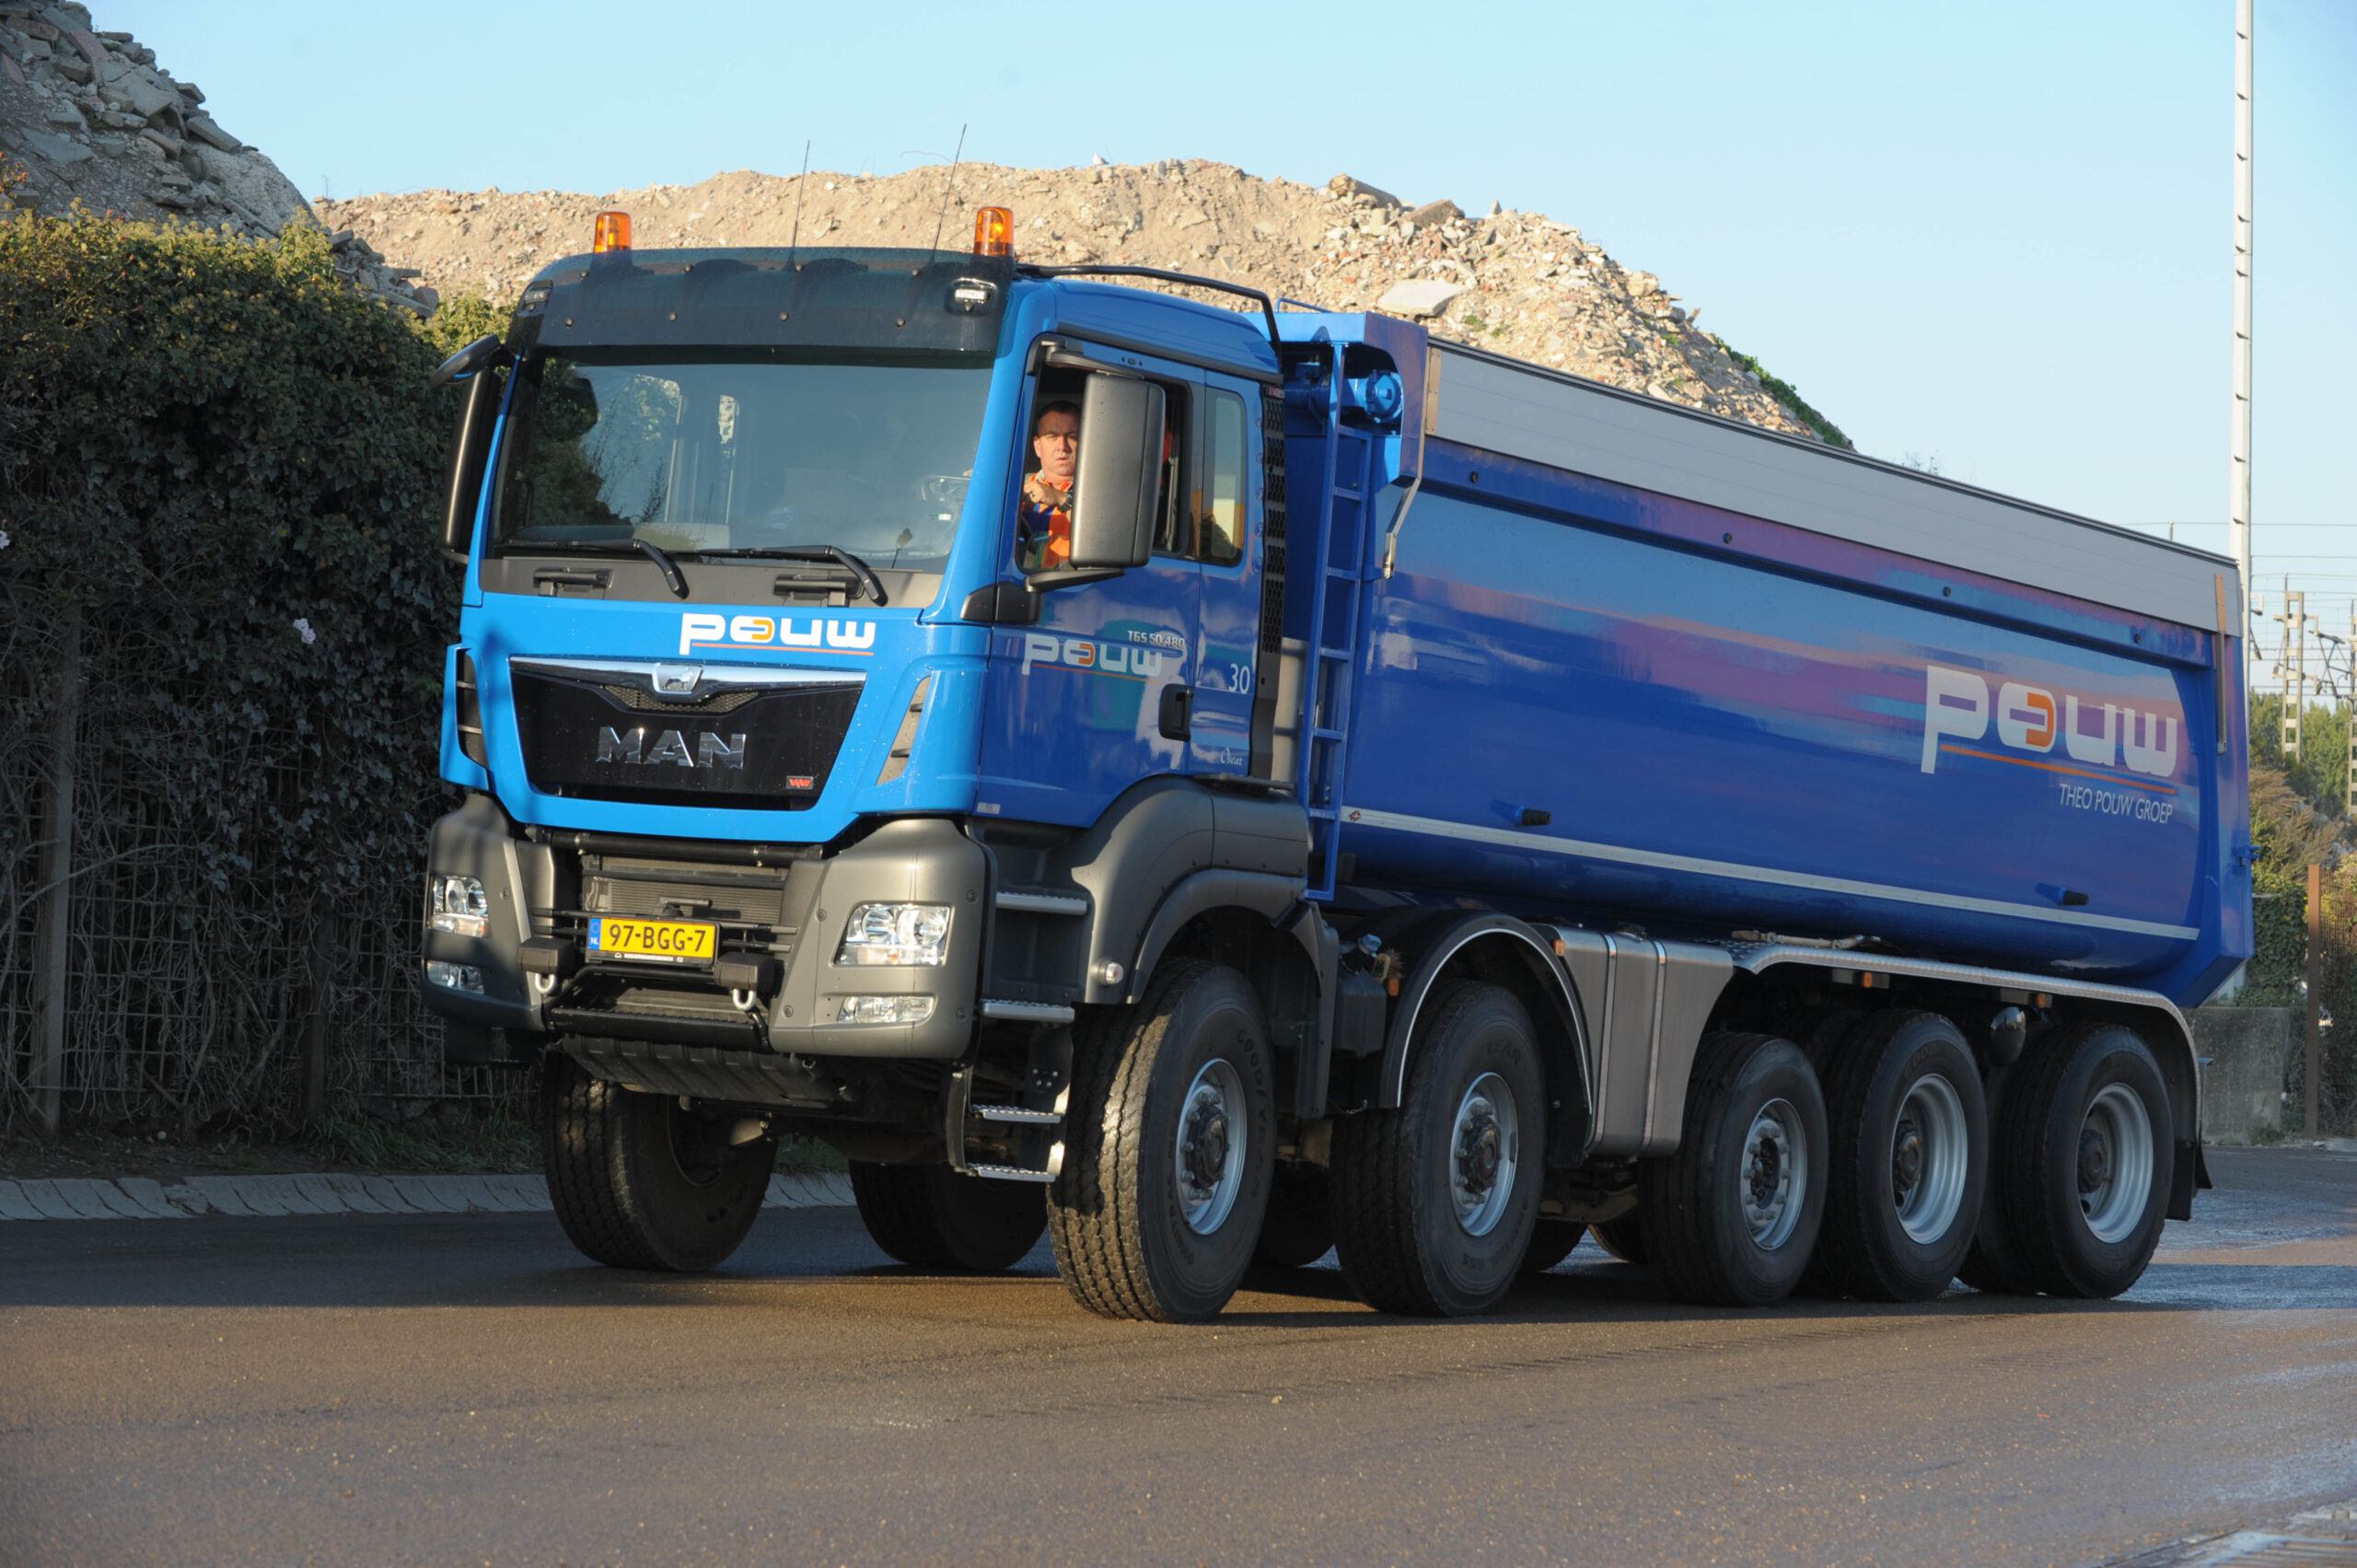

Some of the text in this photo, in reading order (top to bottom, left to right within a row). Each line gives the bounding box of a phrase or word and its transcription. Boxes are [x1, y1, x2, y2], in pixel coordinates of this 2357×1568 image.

[1127, 630, 1147, 644] TGS
[1228, 662, 1251, 694] 30
[597, 726, 747, 770] MAN
[2060, 783, 2173, 825] THEO POUW GROEP
[590, 936, 599, 946] NL
[609, 923, 707, 953] 97-BGG-7
